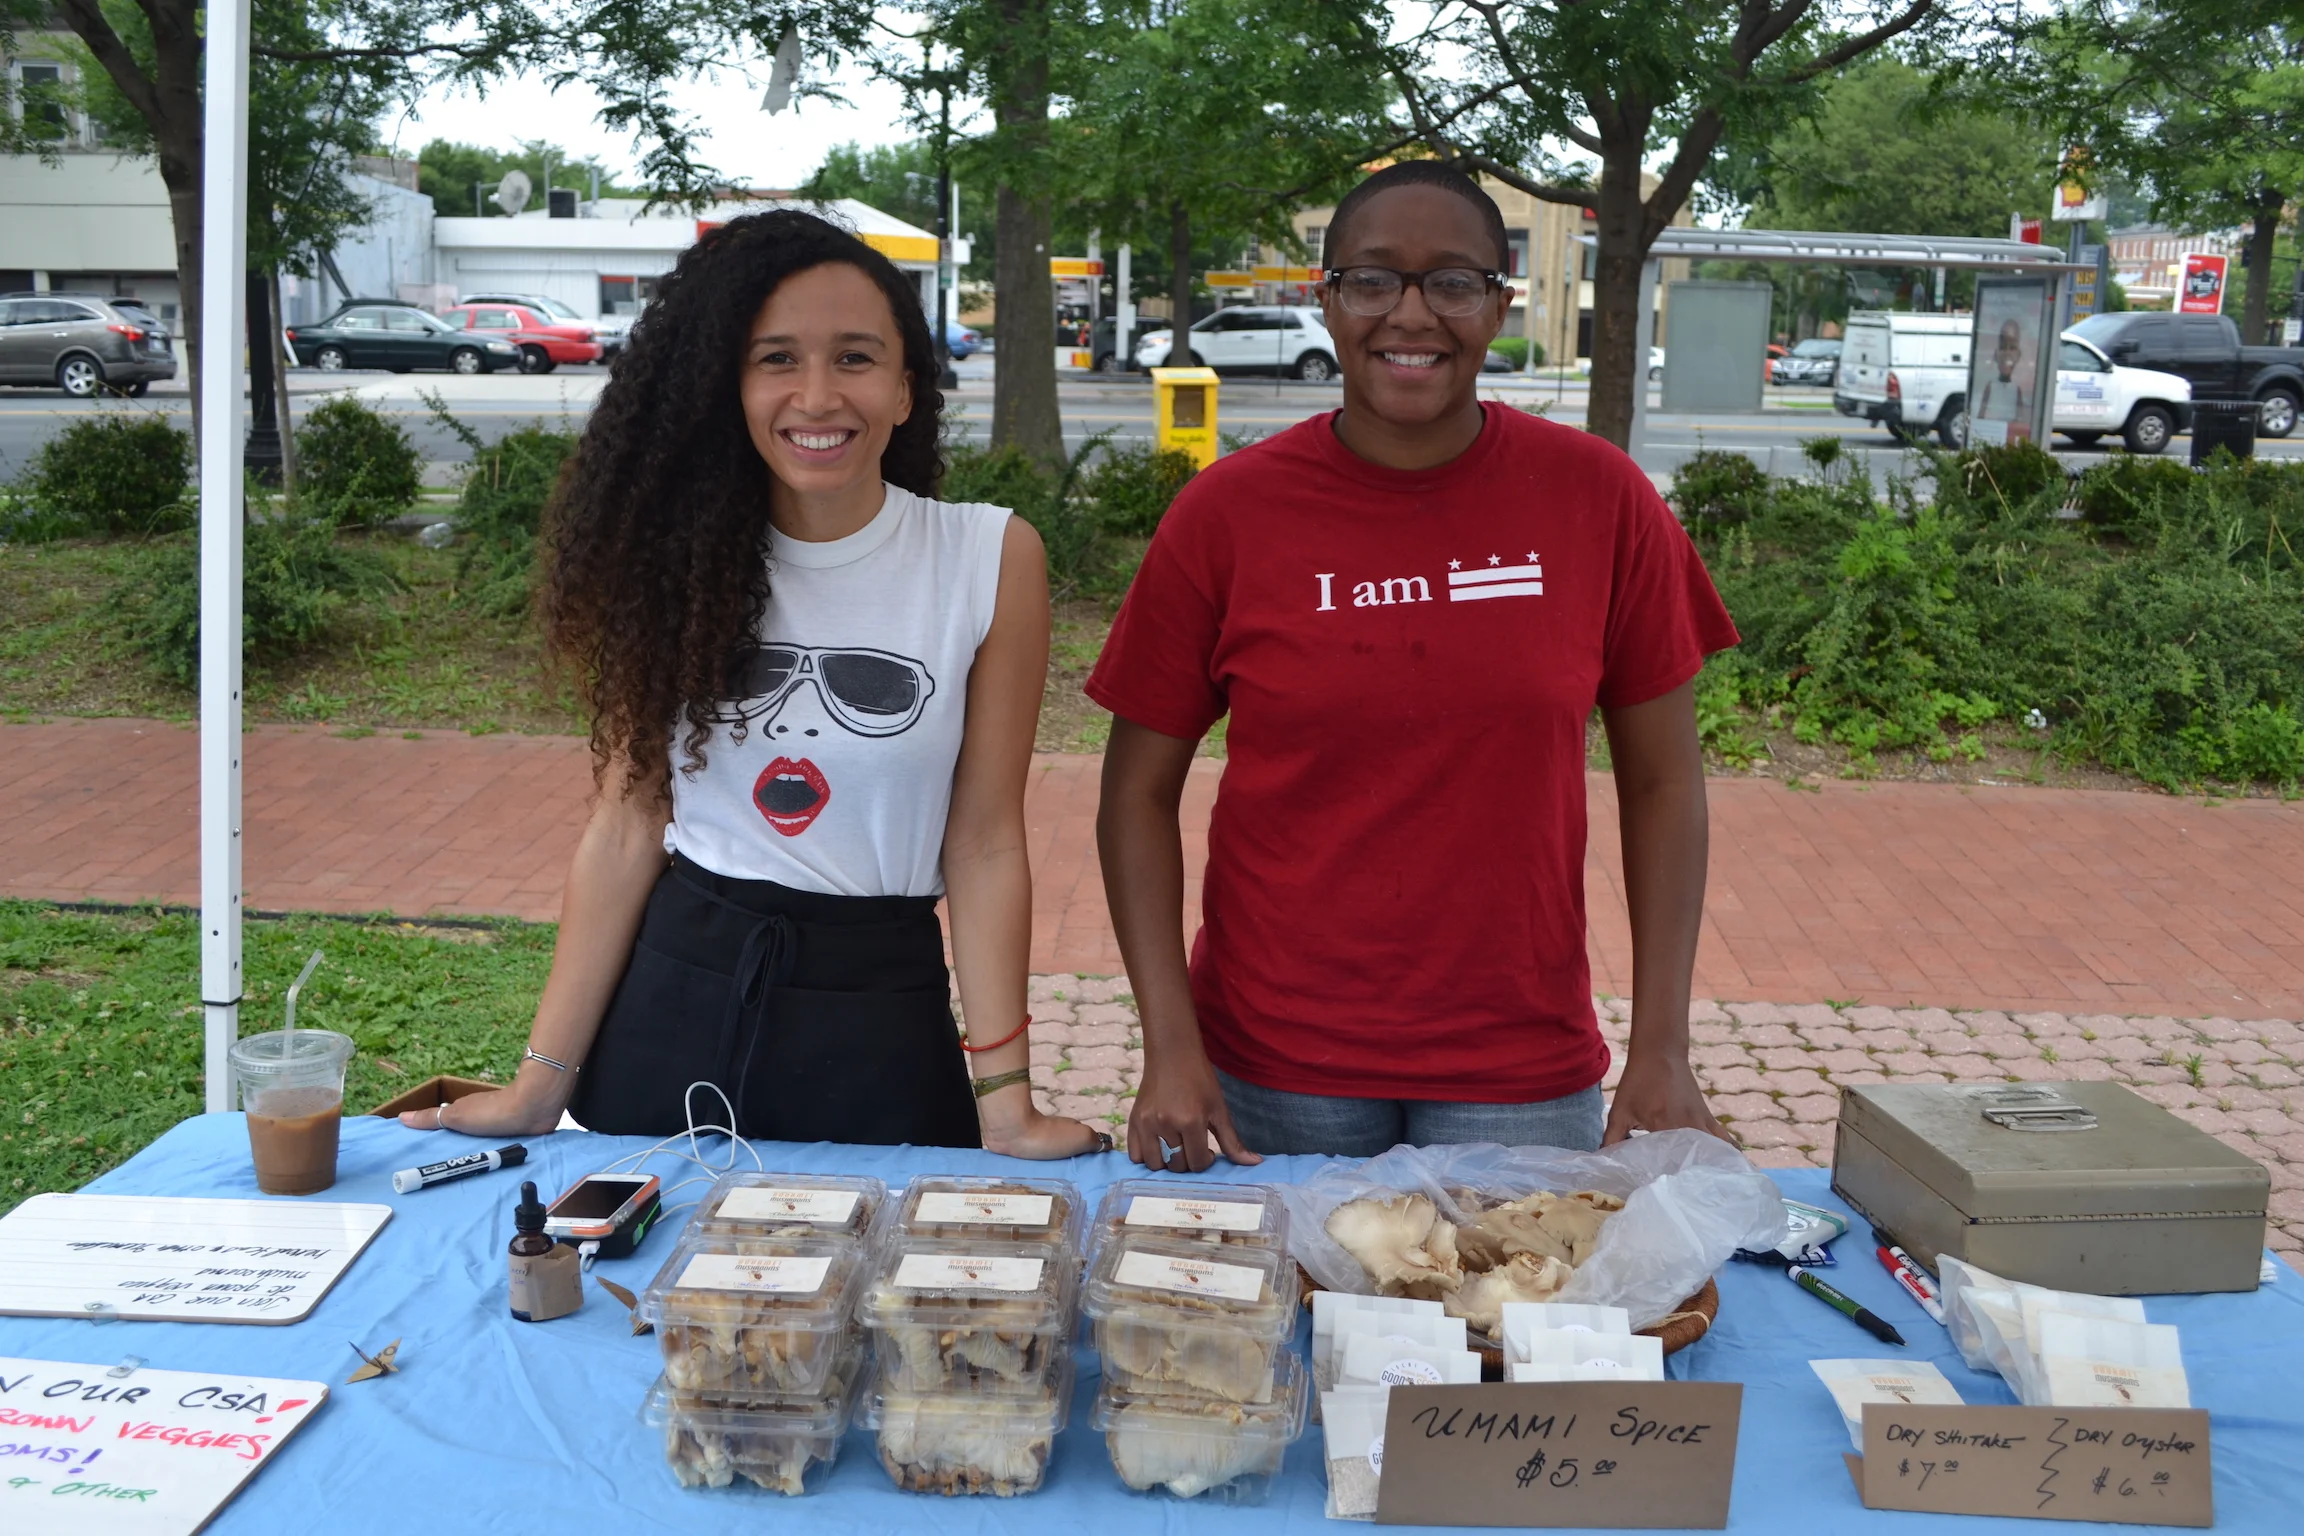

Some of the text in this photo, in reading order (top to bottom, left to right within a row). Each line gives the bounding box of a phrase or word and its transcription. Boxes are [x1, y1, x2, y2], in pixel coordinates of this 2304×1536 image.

[1315, 573, 1433, 612] I am
[43, 1379, 151, 1404] OUR
[1411, 1406, 1577, 1443] UMAMI
[1886, 1424, 1926, 1448] DRY
[2074, 1428, 2114, 1445] DRY
[118, 1421, 272, 1460] VEGGIES
[51, 1482, 158, 1502] OTHER
